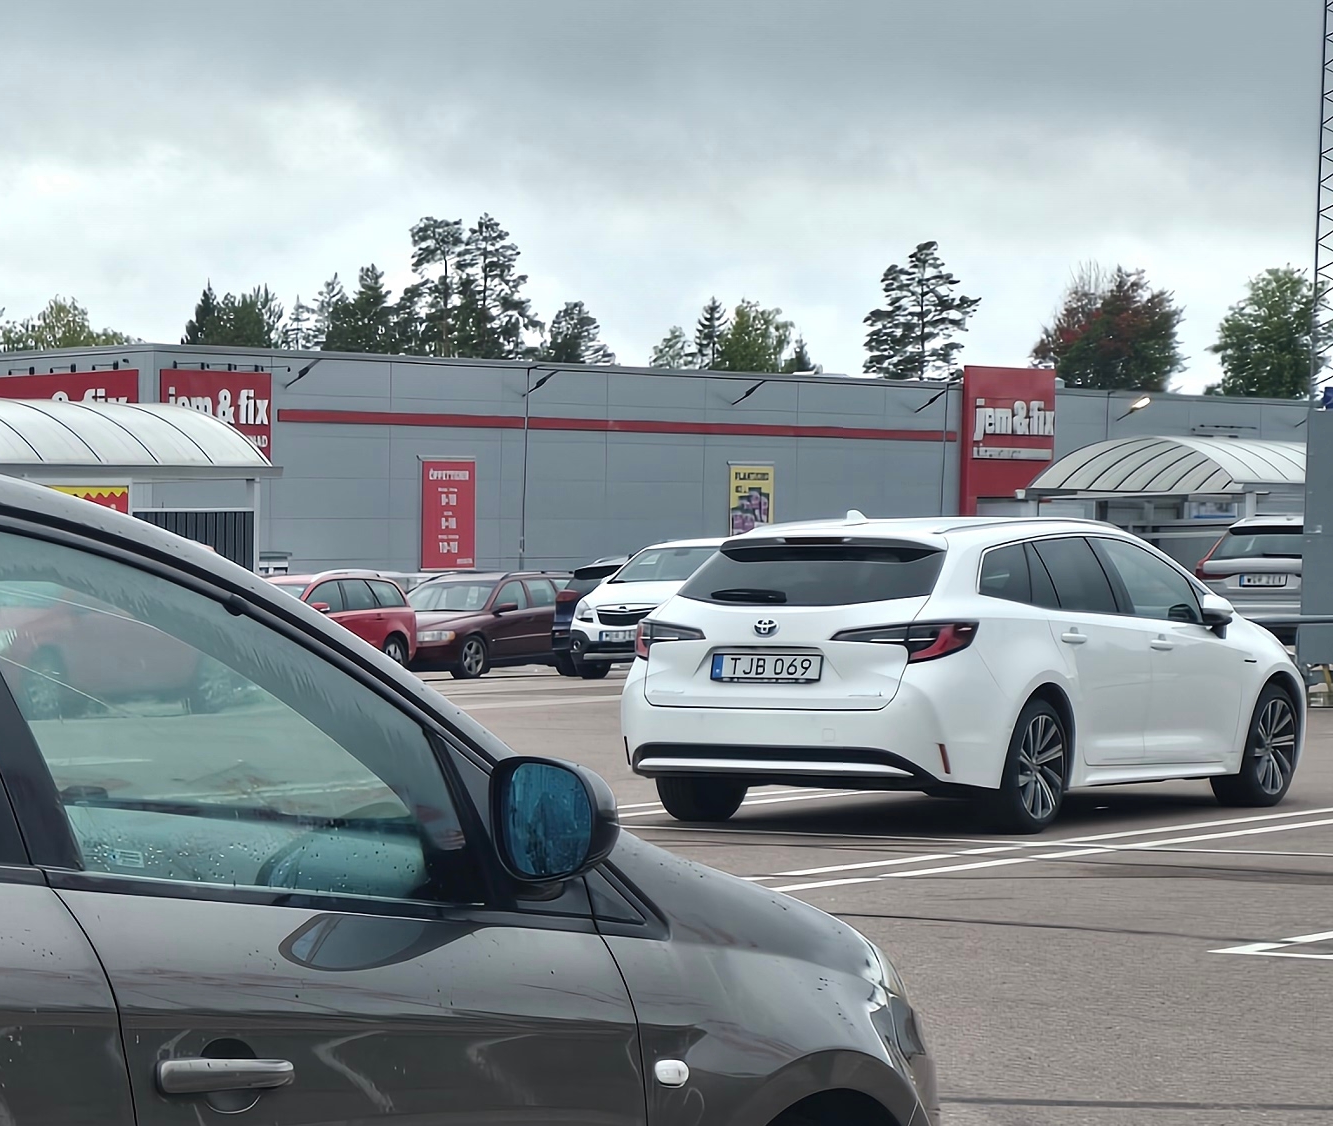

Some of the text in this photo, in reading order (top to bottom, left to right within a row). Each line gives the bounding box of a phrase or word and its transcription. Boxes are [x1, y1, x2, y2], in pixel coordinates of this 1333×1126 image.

[217, 388, 235, 424] &
[238, 389, 269, 425] fix
[973, 398, 1012, 441] jem
[1030, 400, 1055, 435] fix
[730, 657, 812, 677] TJB 069
